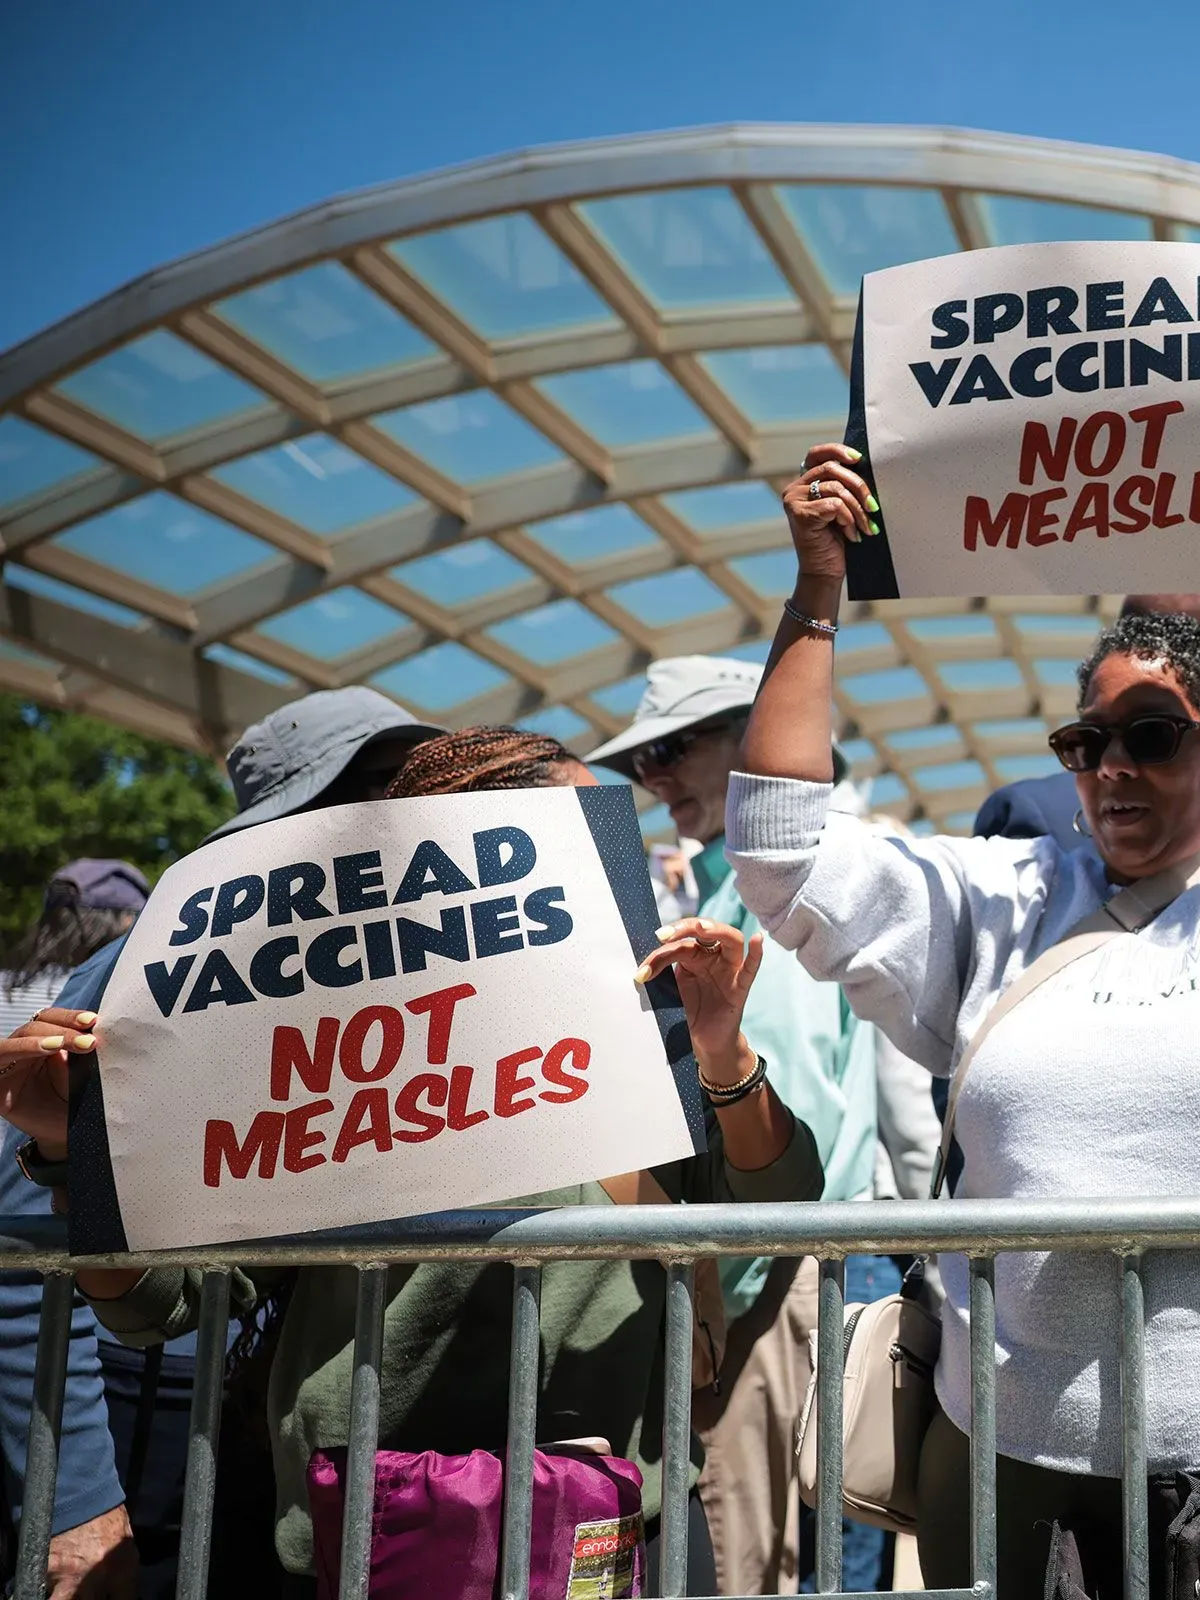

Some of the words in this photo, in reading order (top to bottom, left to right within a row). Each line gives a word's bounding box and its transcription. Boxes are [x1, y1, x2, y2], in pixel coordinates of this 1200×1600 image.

[1019, 401, 1184, 485] NOT
[169, 826, 537, 946] SPREAD
[144, 886, 574, 1019] VACCINES
[271, 983, 477, 1101] NOT
[203, 1038, 591, 1188] MEASLES
